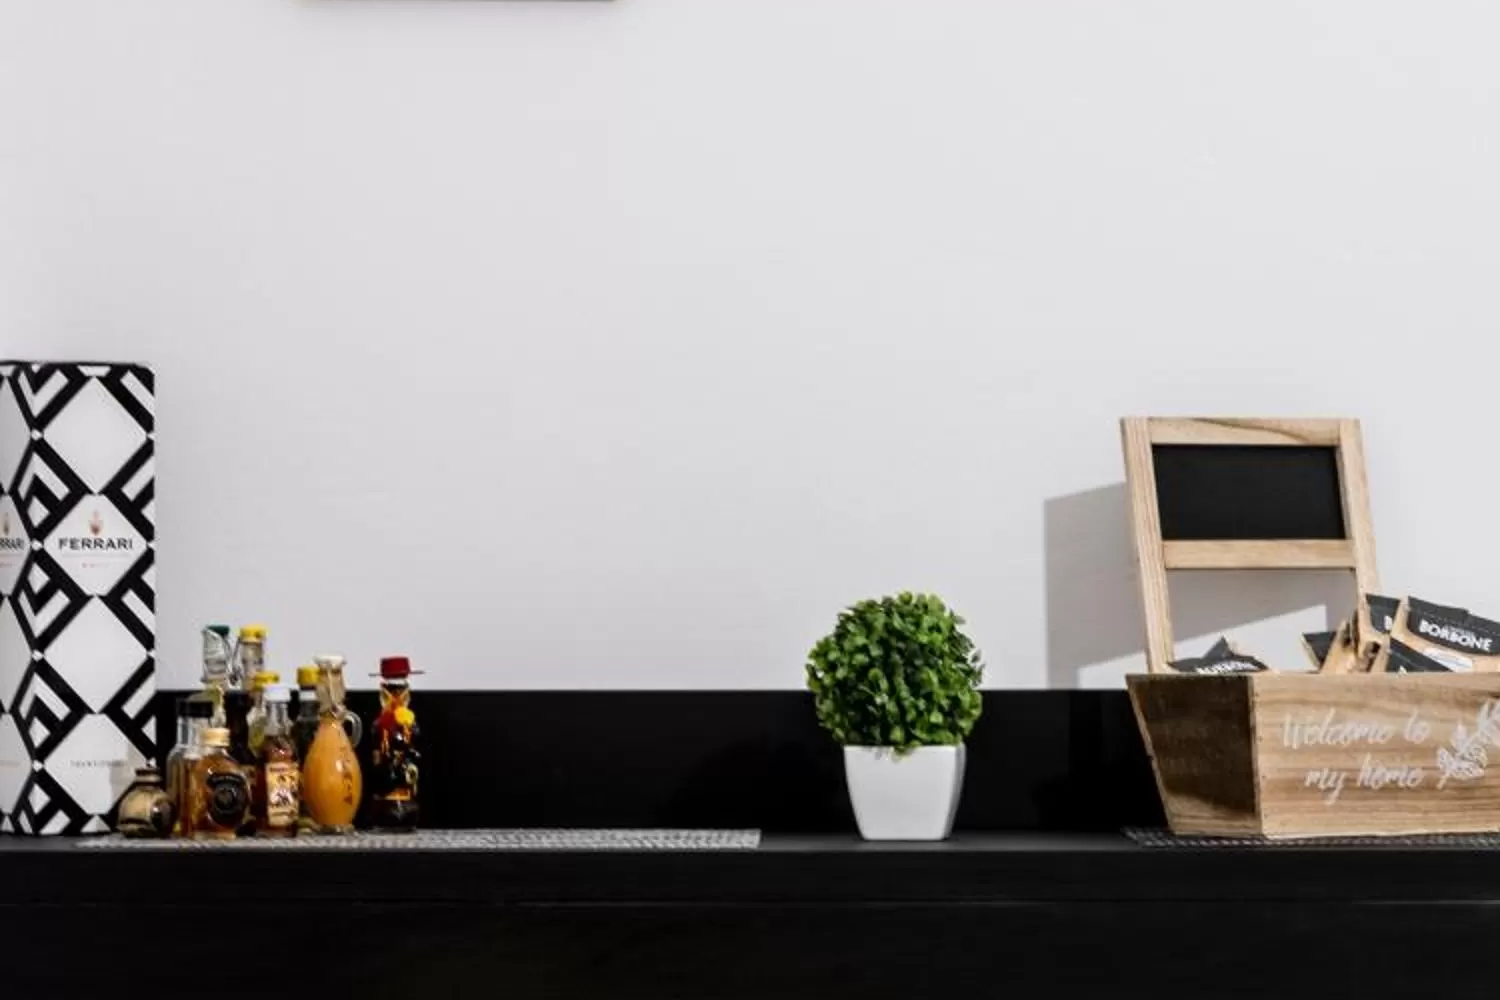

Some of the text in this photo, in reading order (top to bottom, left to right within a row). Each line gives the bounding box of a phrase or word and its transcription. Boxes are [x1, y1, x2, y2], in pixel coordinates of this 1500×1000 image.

[57, 537, 133, 550] FERRARI
[1419, 619, 1493, 652] BORBONE
[1282, 707, 1431, 749] Welcome to
[1304, 752, 1425, 806] my home
